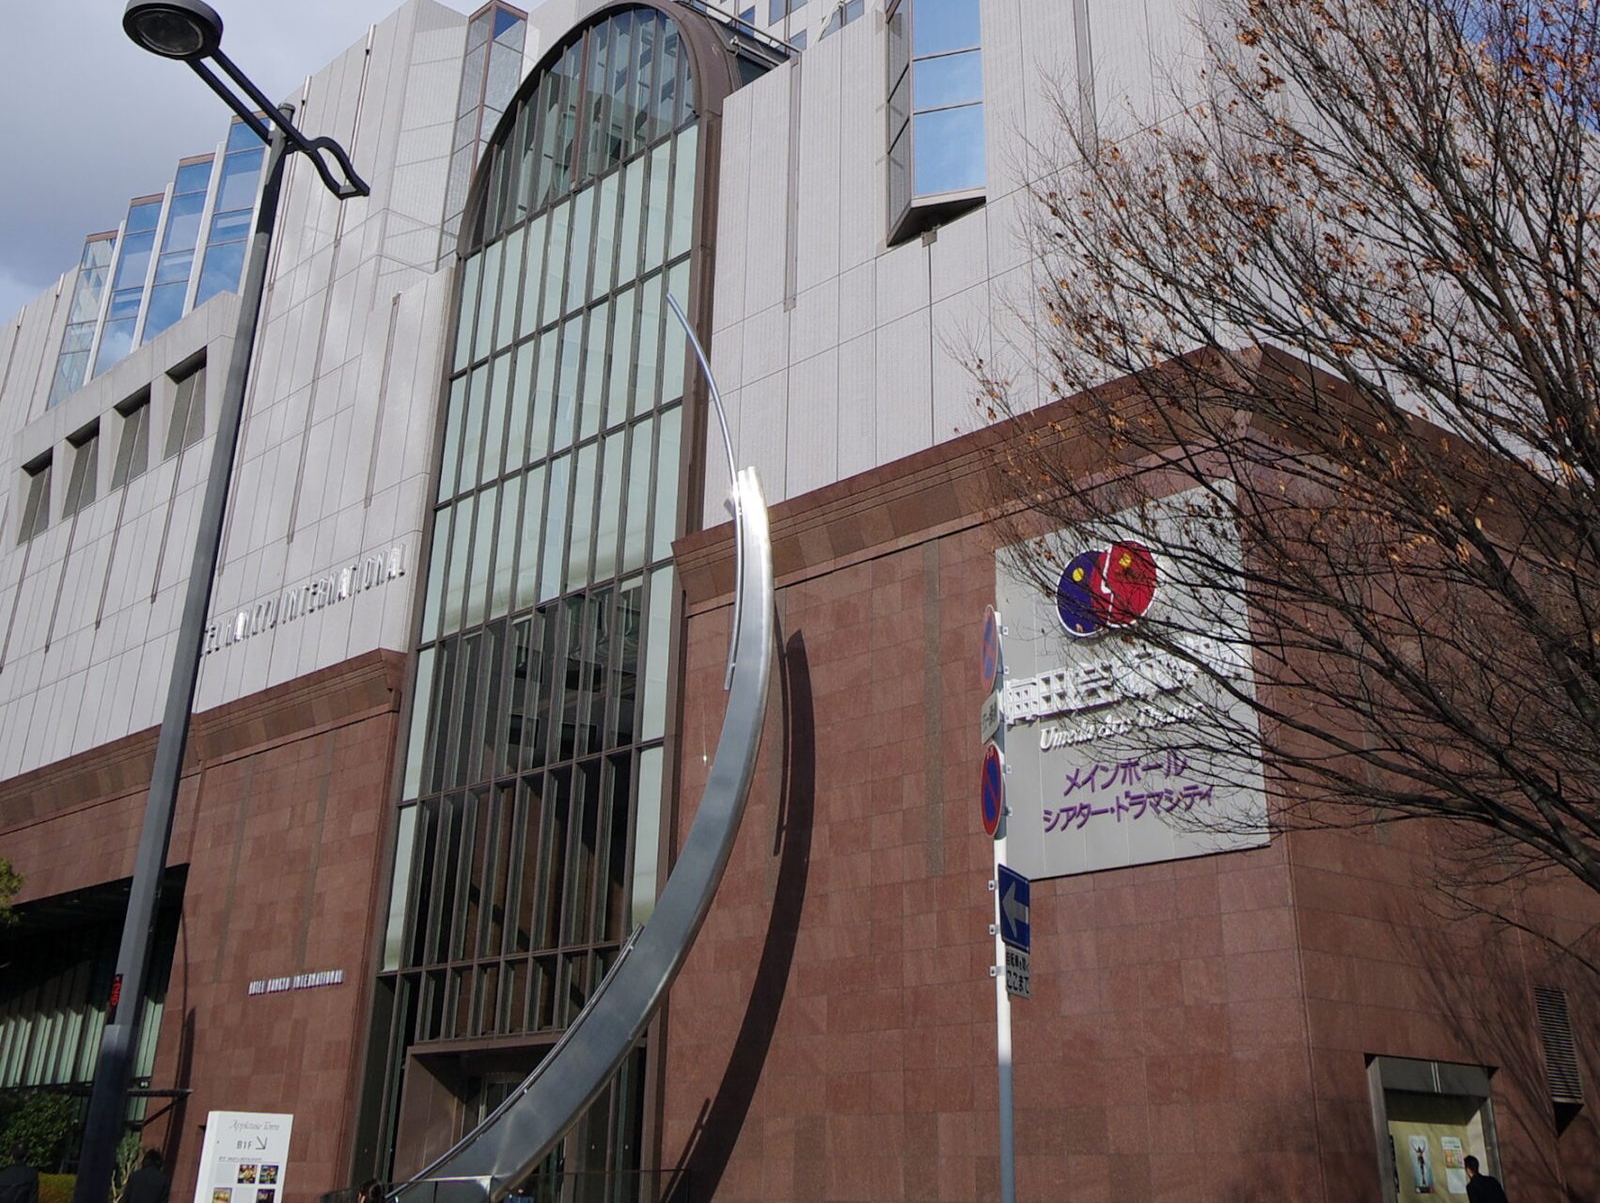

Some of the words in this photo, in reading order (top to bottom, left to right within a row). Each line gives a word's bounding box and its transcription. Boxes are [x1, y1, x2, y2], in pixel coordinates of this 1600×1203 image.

[281, 542, 405, 626] INTERNATIONAL
[1063, 751, 1187, 797] メインホール
